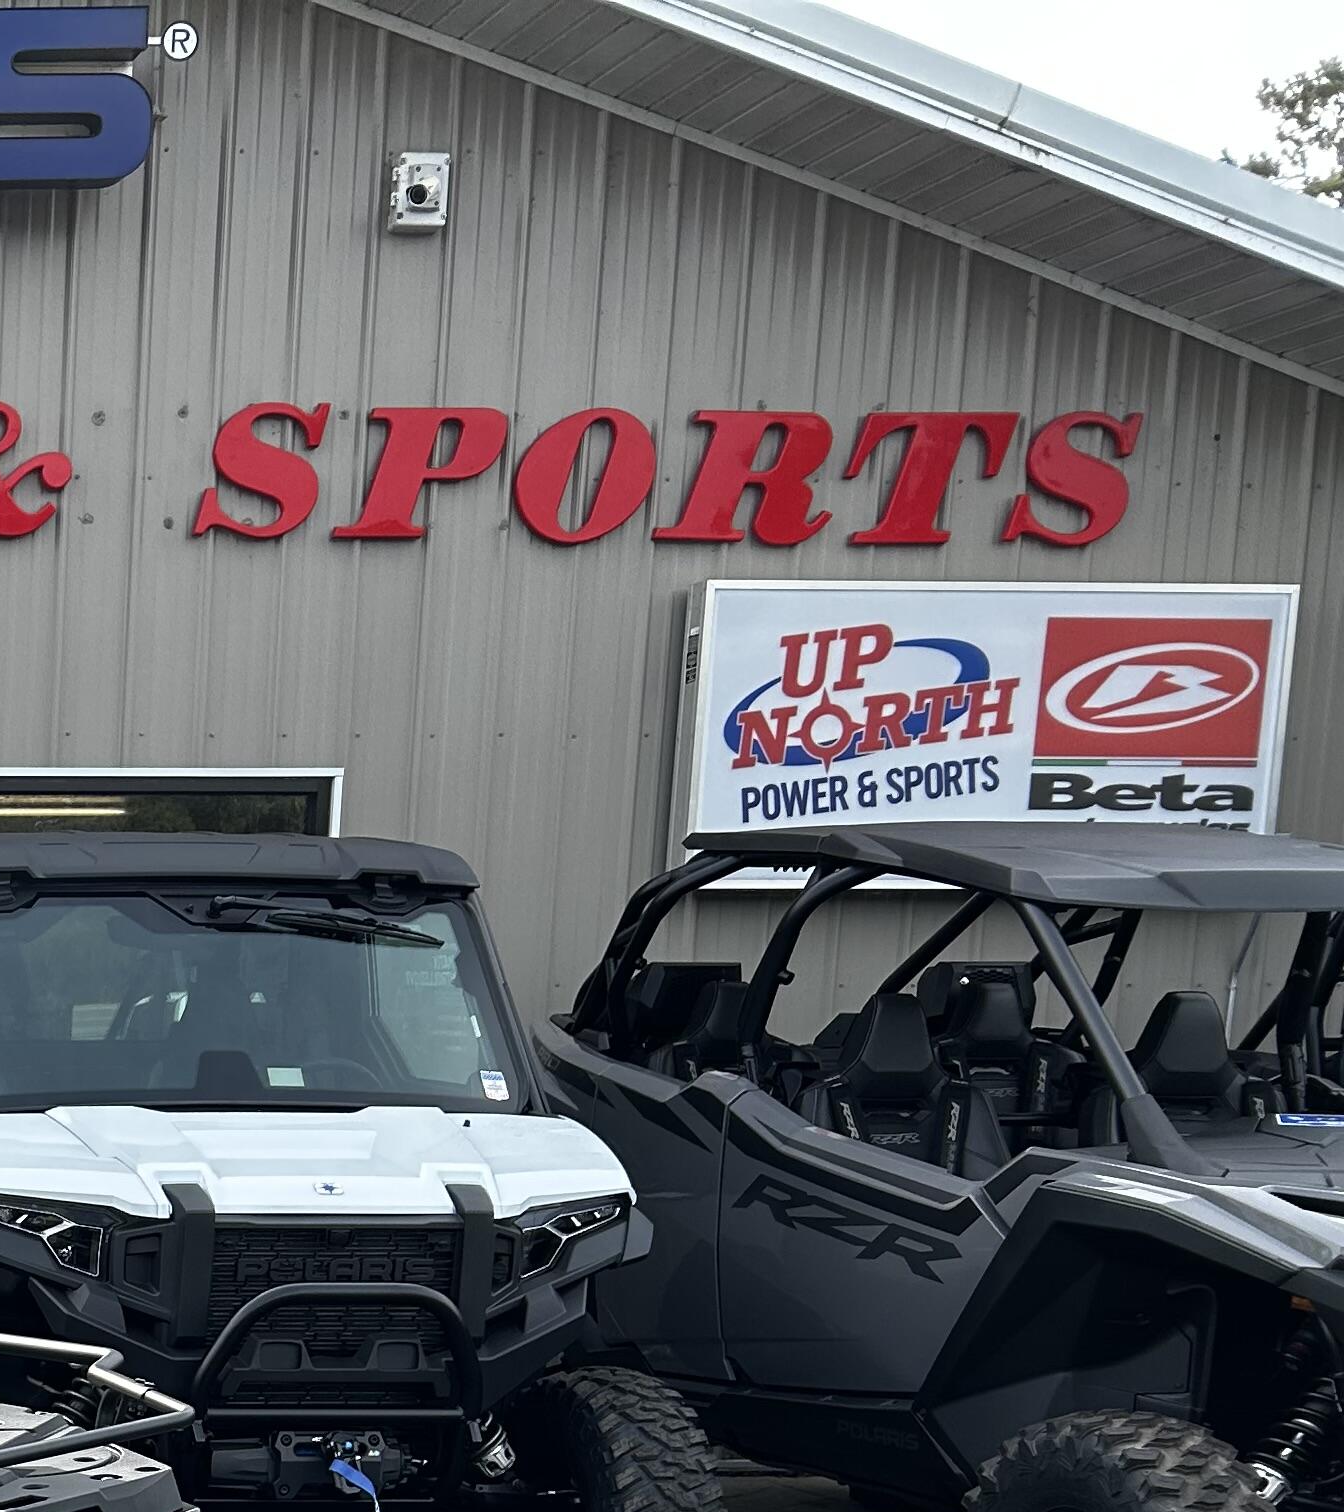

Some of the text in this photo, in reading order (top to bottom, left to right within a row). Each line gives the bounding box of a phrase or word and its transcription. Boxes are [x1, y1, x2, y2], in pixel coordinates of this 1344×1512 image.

[193, 401, 1144, 547] SPORTS
[780, 623, 895, 699] UP
[732, 677, 1021, 772] NORTH
[741, 755, 1001, 823] POWER & SPORTS
[1028, 772, 1255, 812] Beta
[731, 1173, 963, 1285] RZR
[236, 1257, 435, 1282] POLARIS
